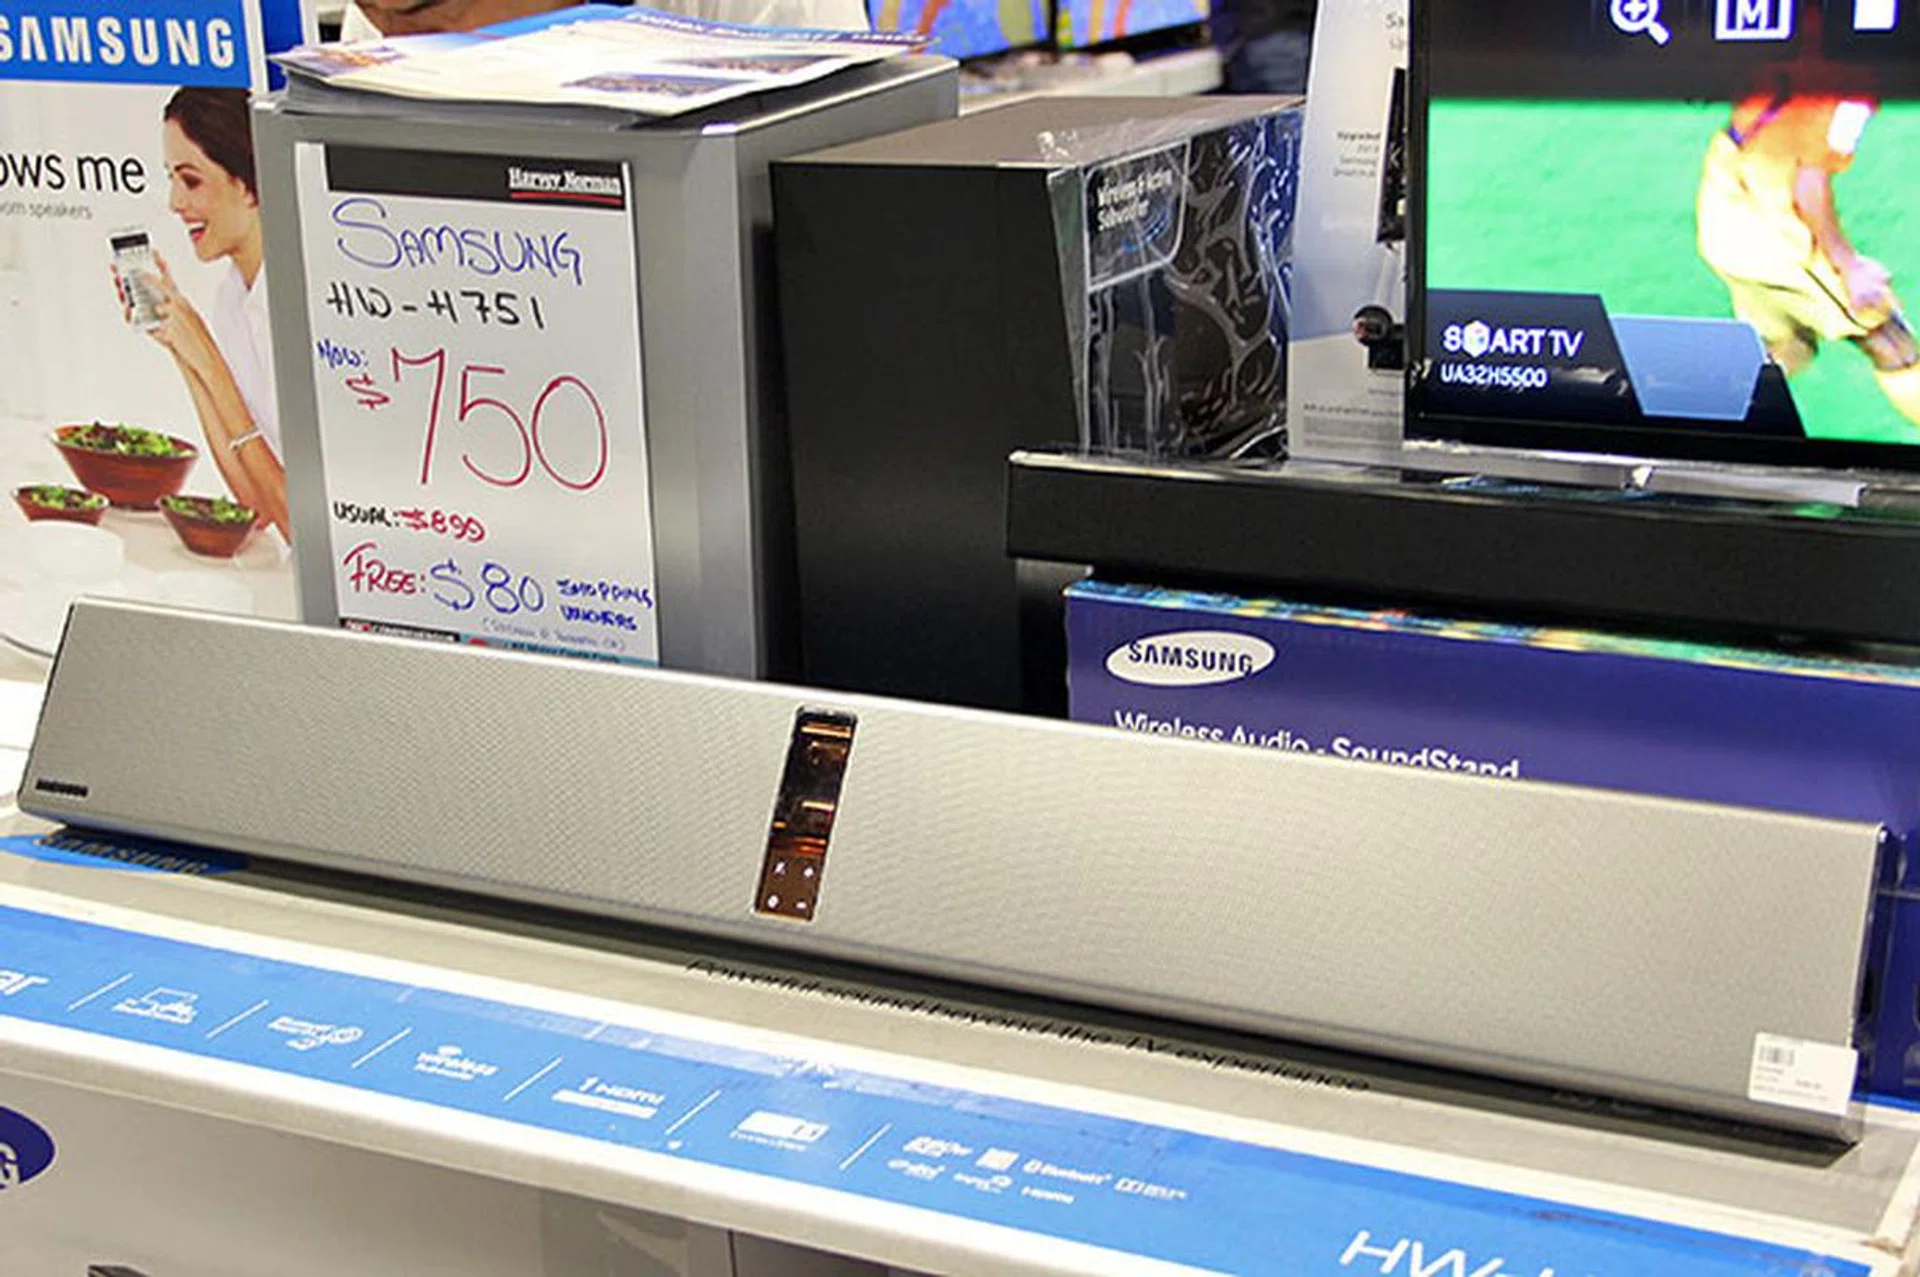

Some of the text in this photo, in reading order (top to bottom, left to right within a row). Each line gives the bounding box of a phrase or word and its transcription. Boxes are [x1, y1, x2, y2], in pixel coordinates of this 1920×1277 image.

[77, 156, 145, 194] me
[332, 197, 582, 286] SAMSUNG
[1547, 328, 1584, 357] TV
[1440, 363, 1548, 389] UA32H5500
[345, 347, 608, 491] $750
[343, 542, 426, 595] FREE:
[429, 558, 544, 615] $80
[1128, 641, 1254, 677] SAMSUNG
[1231, 725, 1310, 751] Audio
[1174, 1048, 1372, 1090] experience
